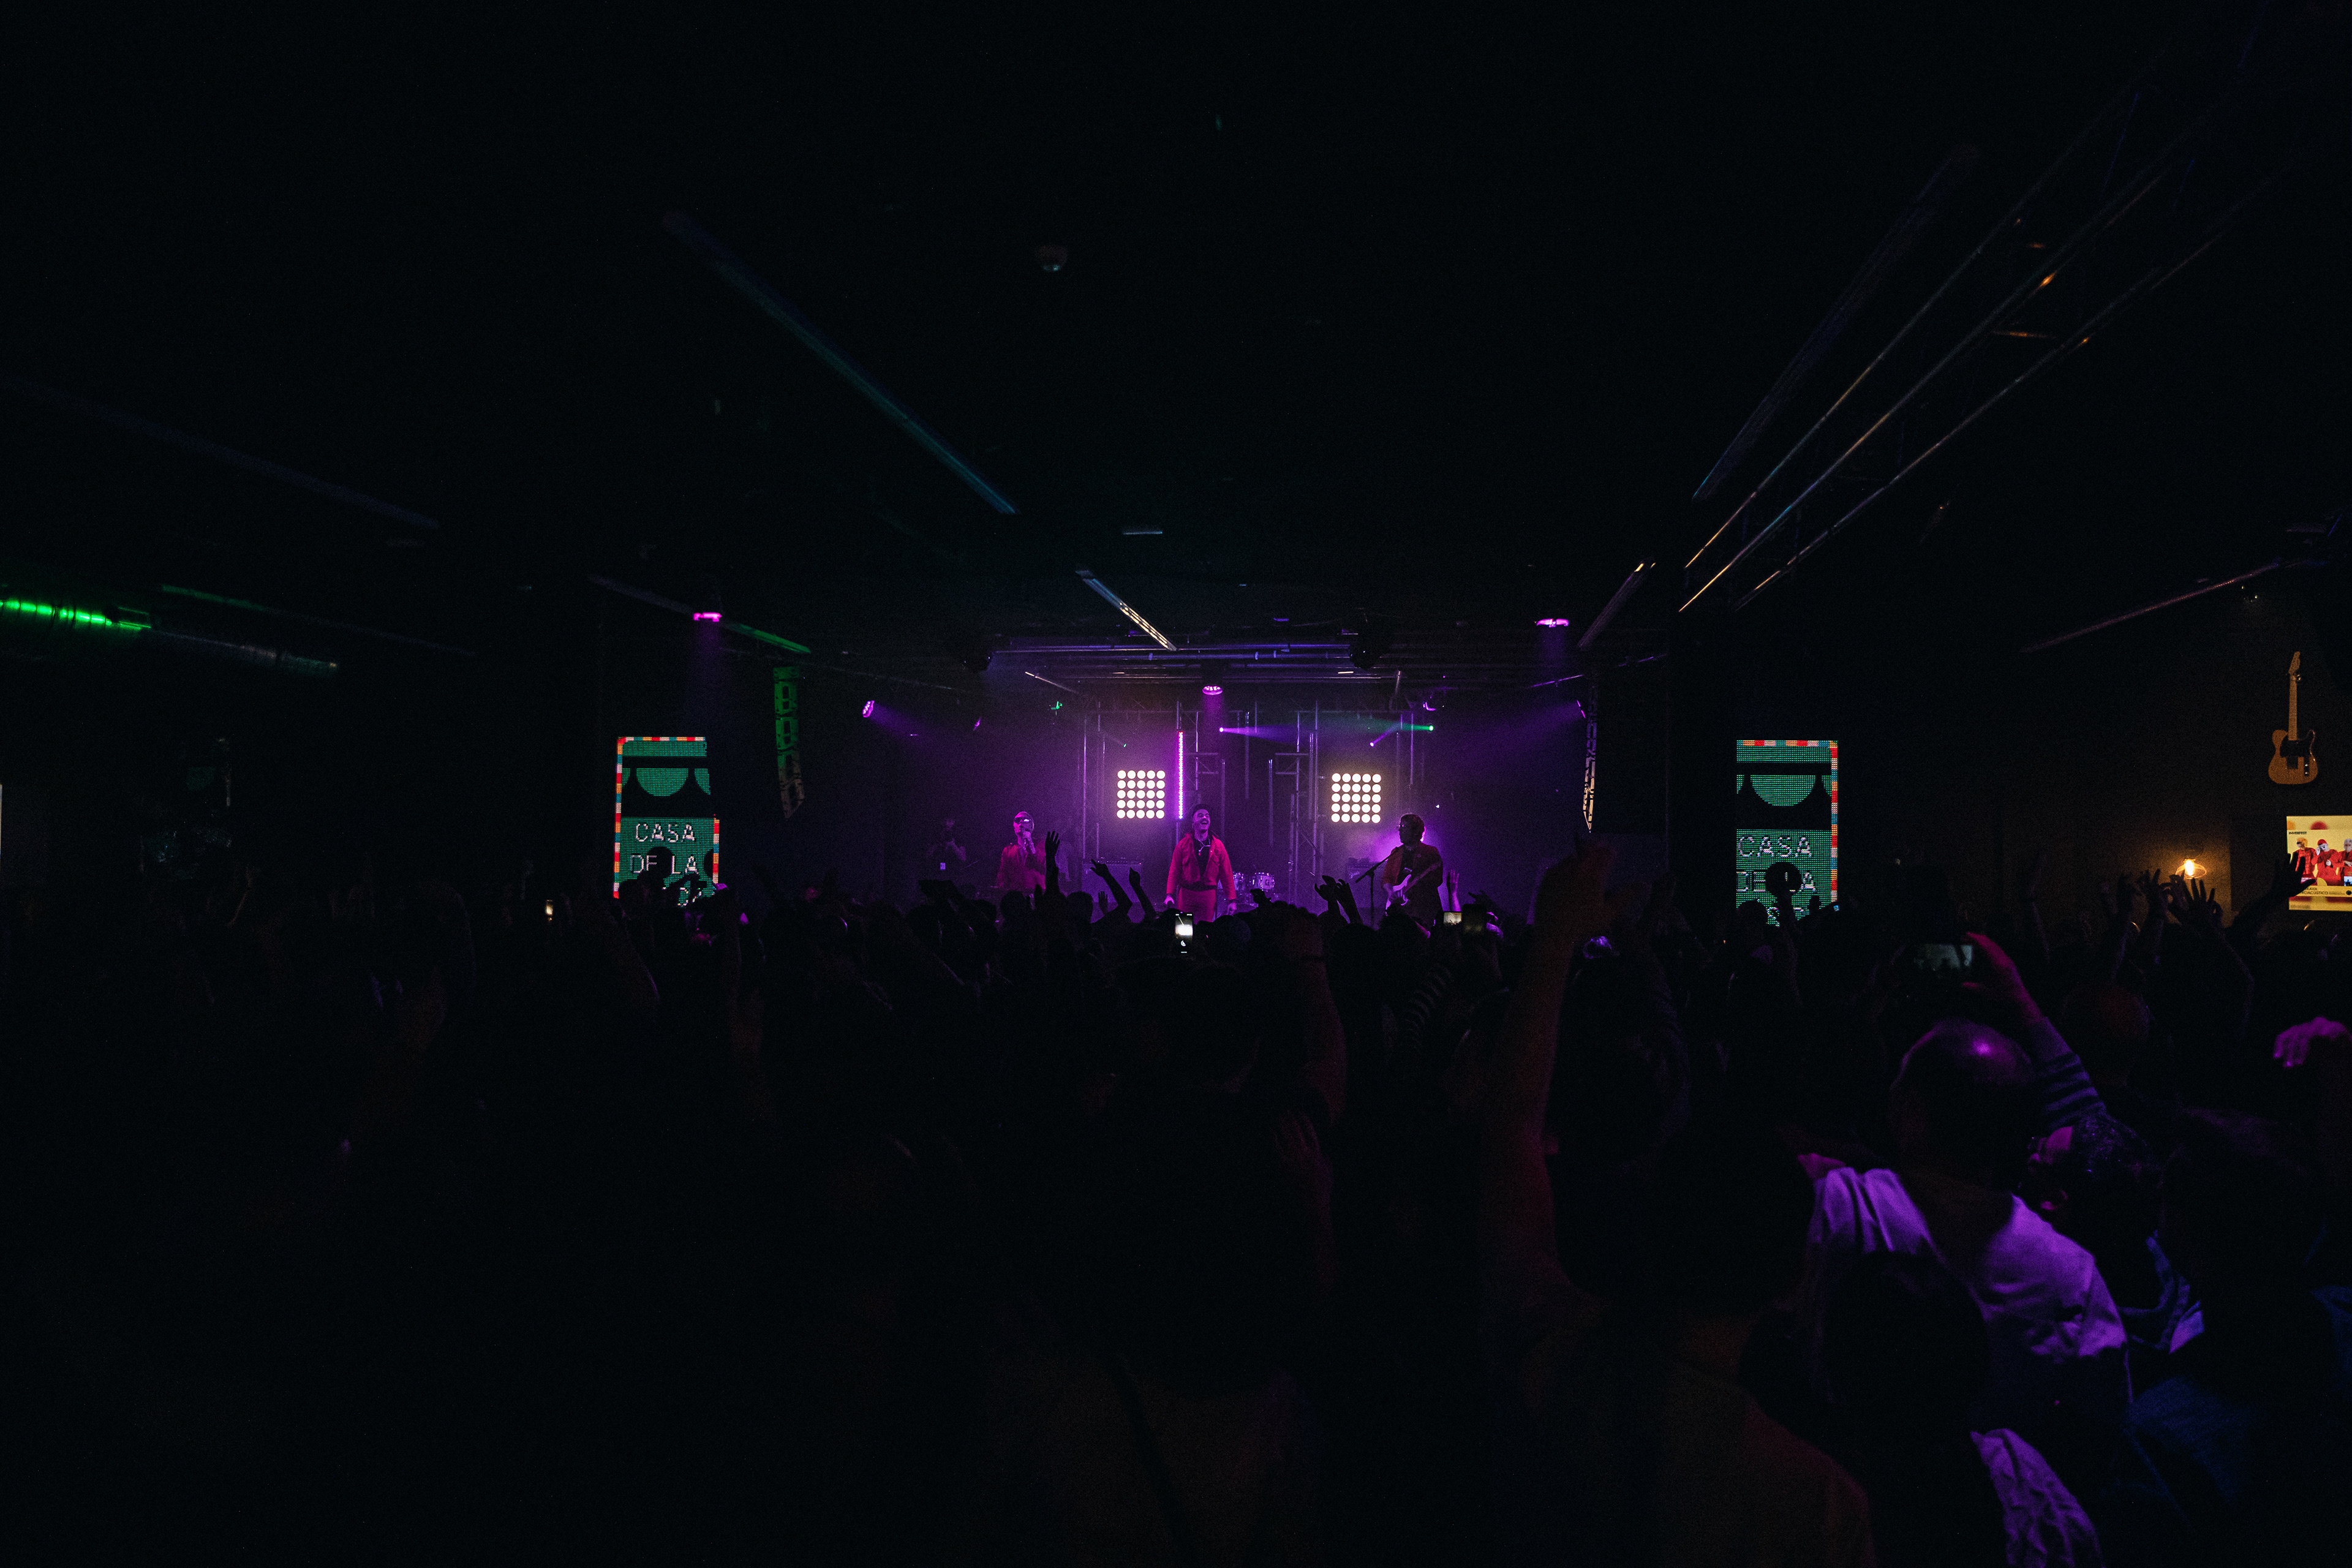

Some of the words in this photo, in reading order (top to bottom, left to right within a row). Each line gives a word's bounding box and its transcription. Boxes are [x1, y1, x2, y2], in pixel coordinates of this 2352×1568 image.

[636, 824, 696, 842] CASA
[1738, 837, 1812, 858] CASA
[671, 855, 699, 875] LA
